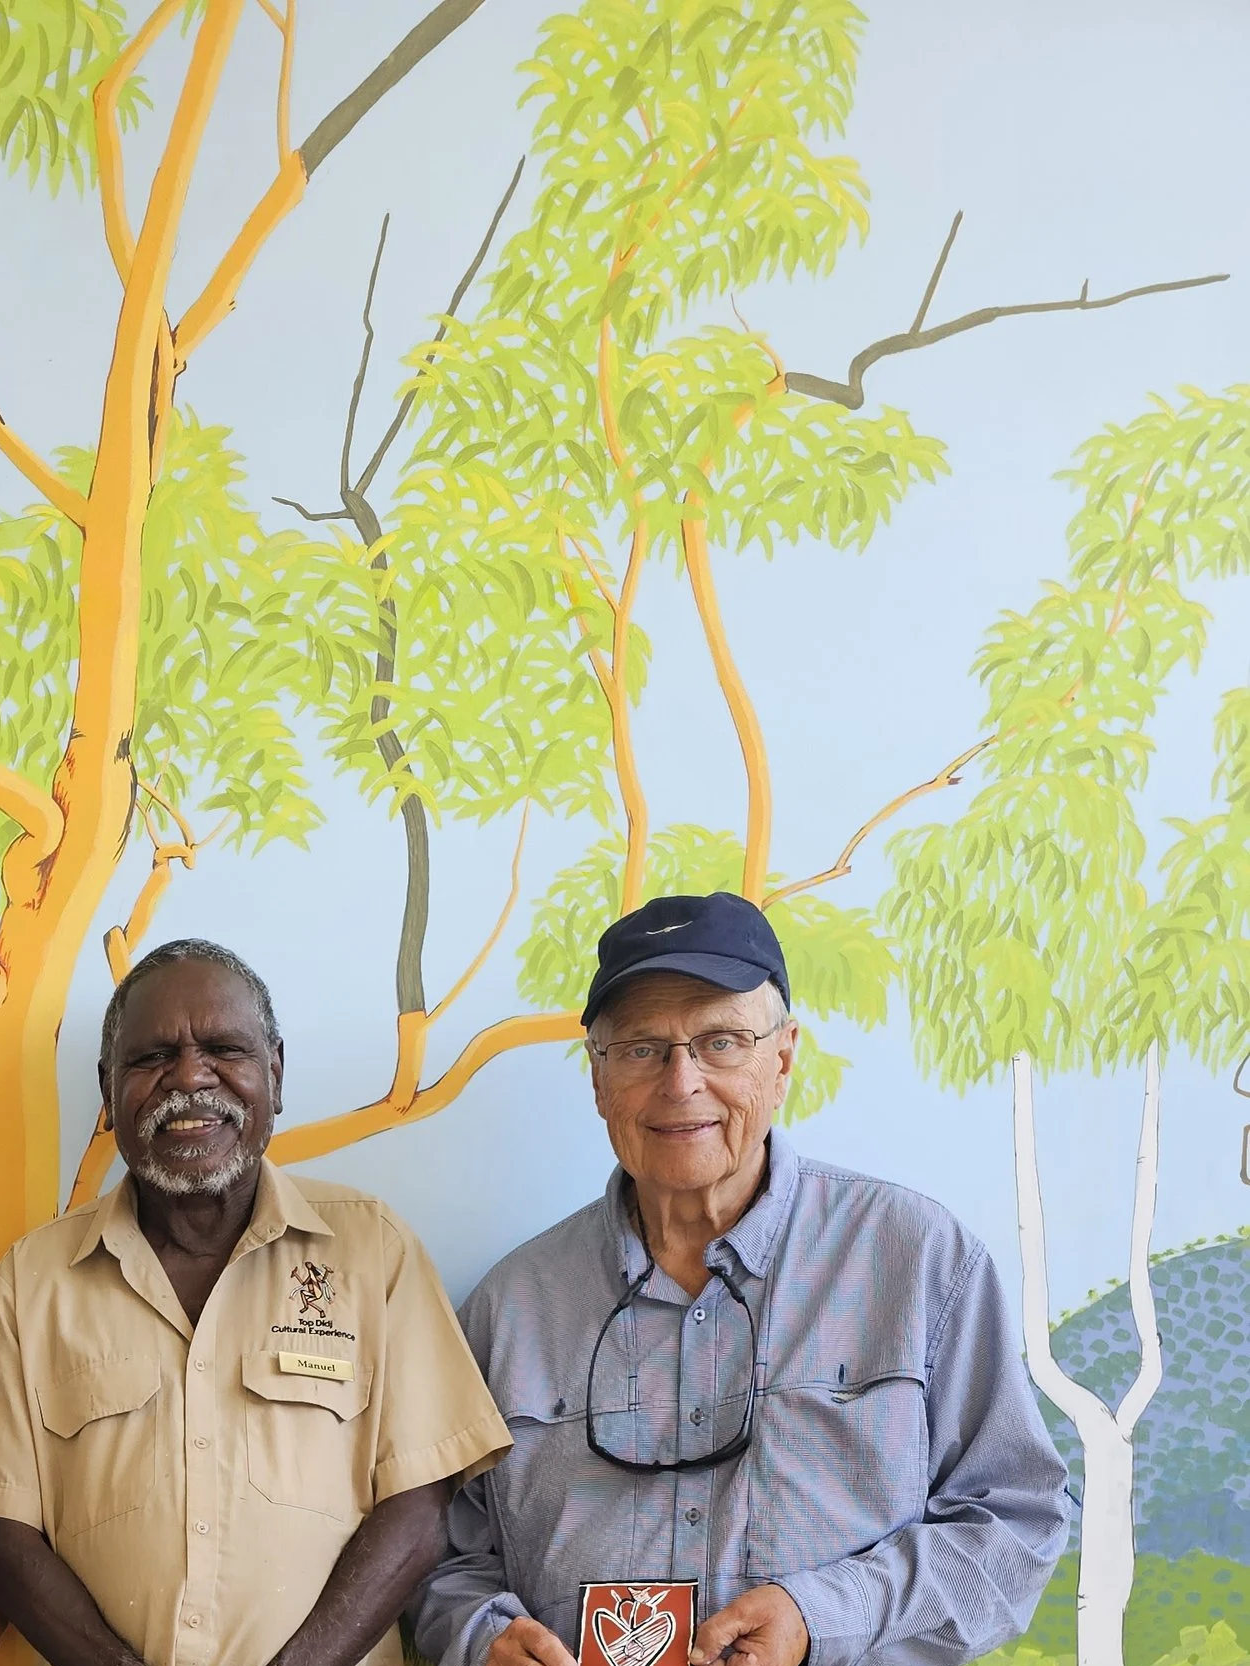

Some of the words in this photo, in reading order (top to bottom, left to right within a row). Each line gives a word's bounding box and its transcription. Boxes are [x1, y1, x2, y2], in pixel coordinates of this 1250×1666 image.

[298, 1319, 314, 1327] Top
[315, 1319, 333, 1329] Didj
[271, 1325, 306, 1334] Cultural
[308, 1327, 356, 1341] Experience
[297, 1359, 336, 1372] Manuel
